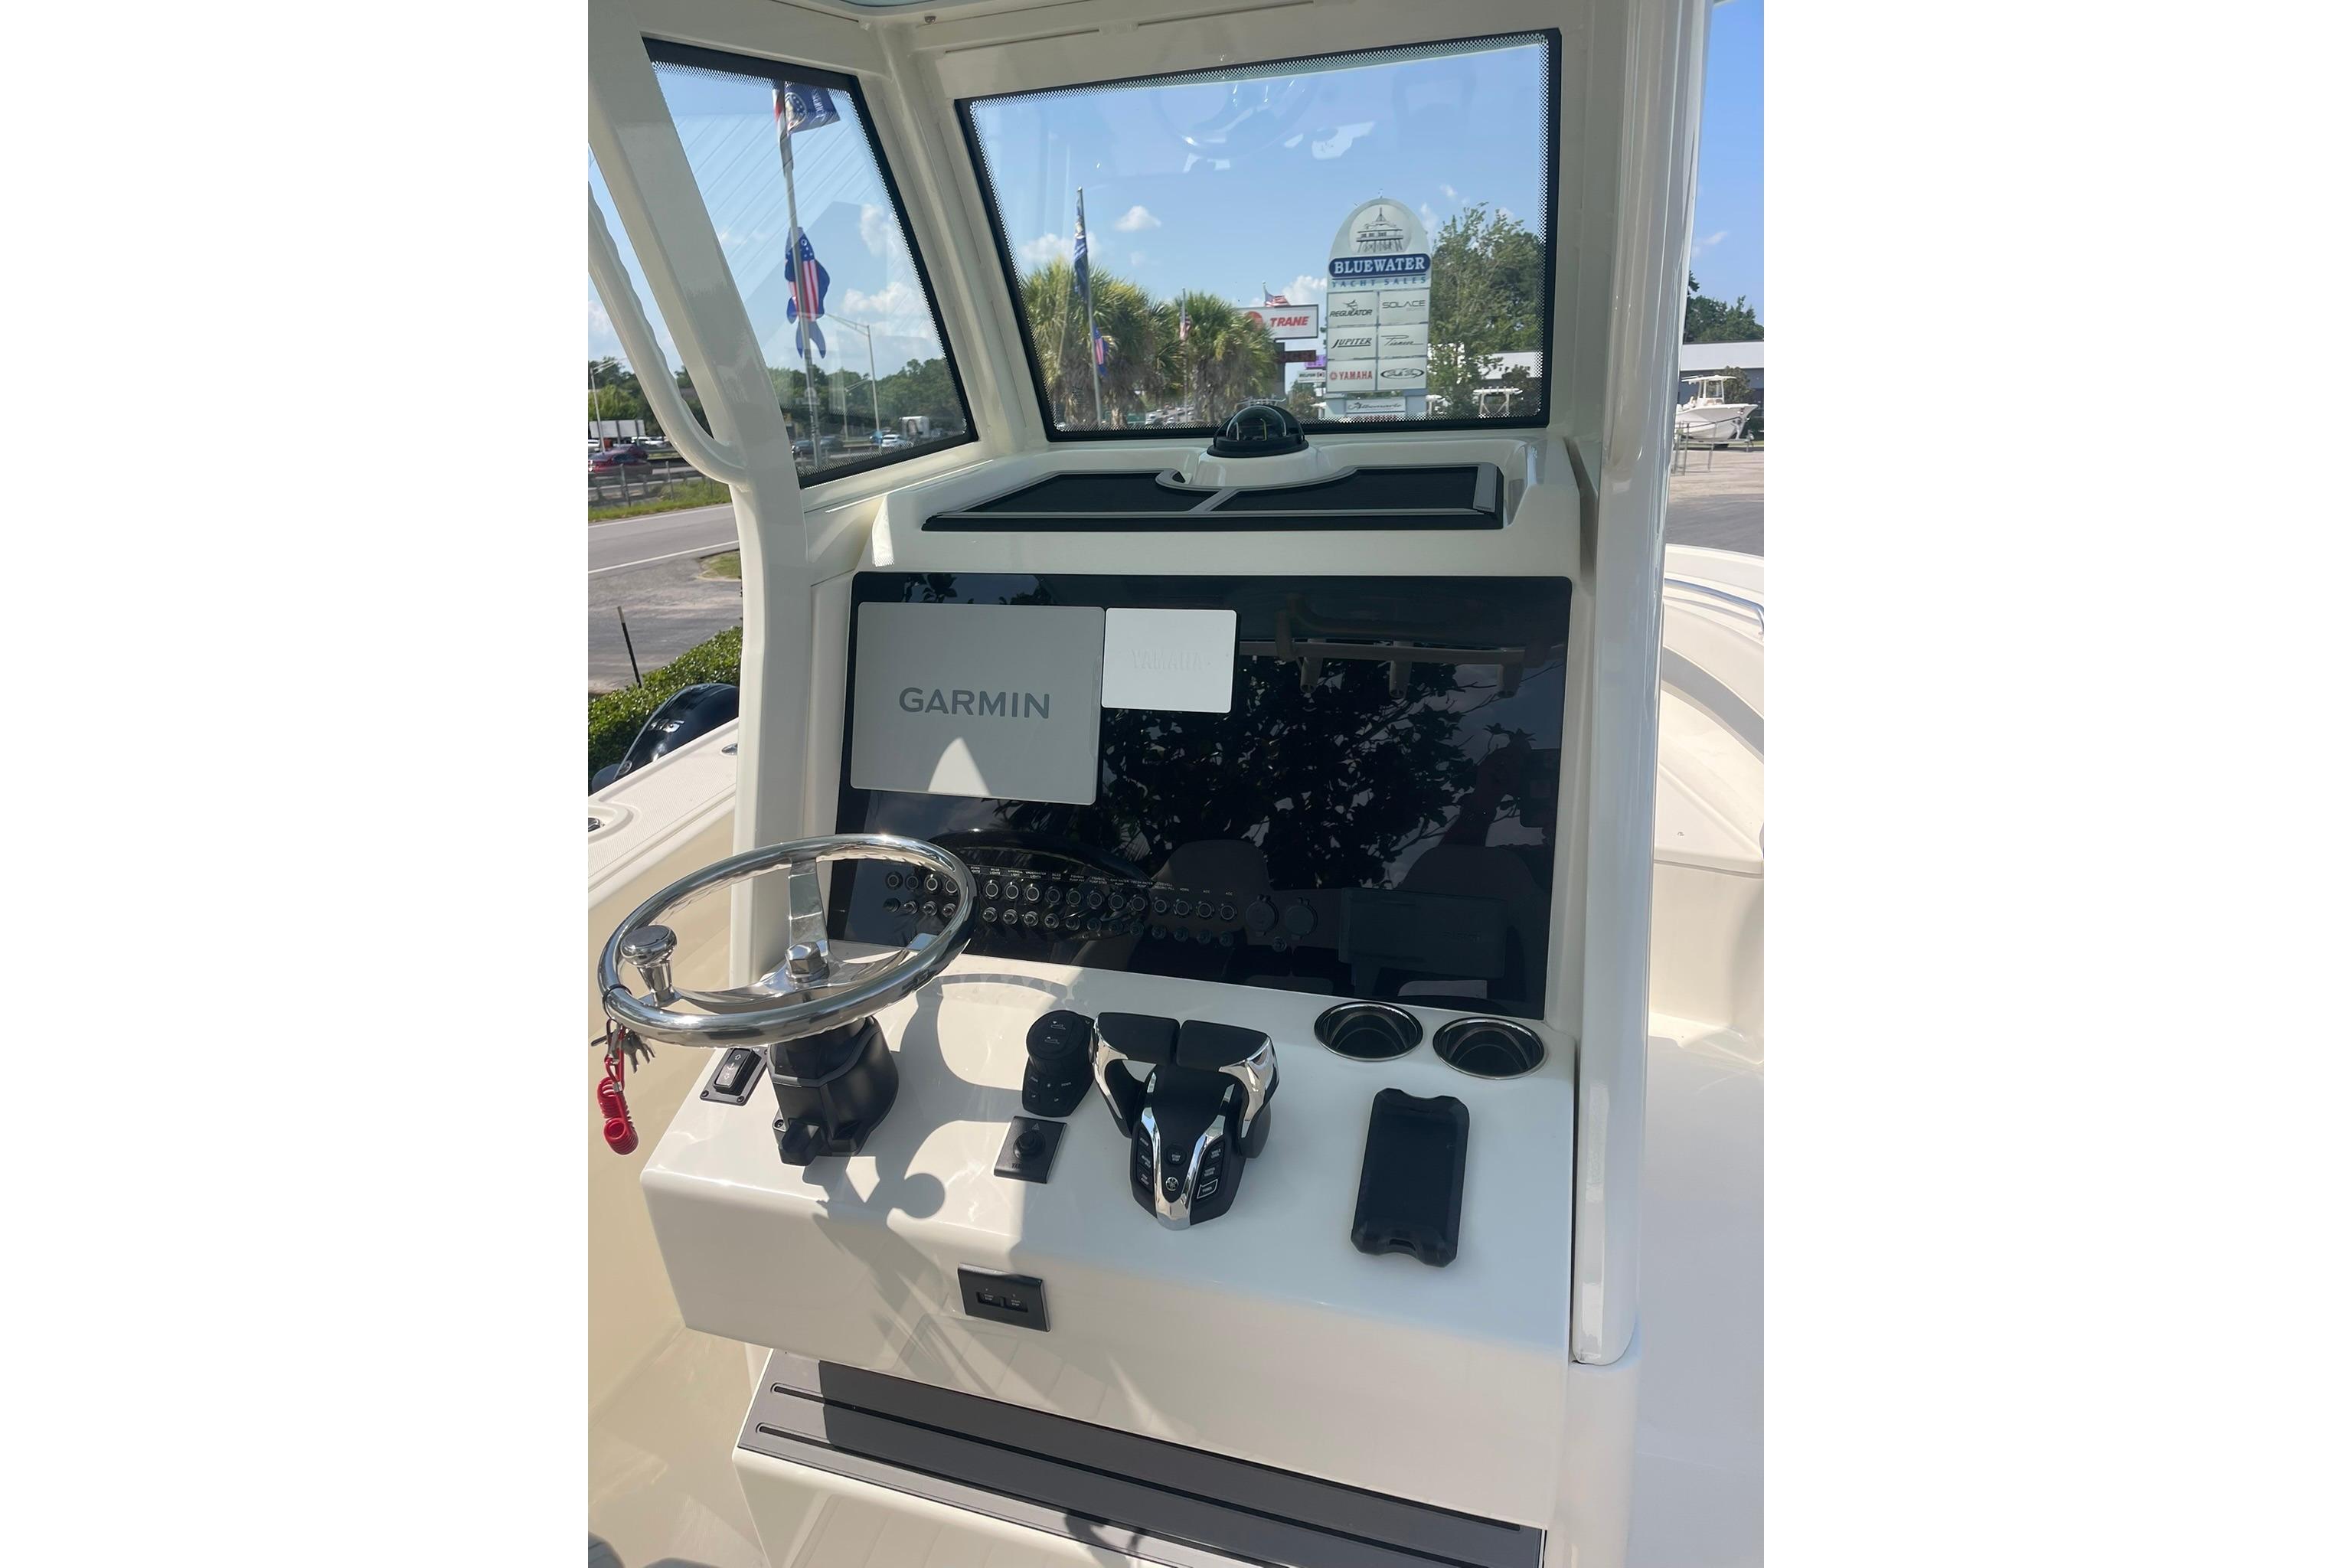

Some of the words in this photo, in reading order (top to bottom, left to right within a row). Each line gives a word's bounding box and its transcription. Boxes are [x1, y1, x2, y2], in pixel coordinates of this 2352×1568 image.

[1334, 256, 1425, 274] BLUEWATER
[1332, 279, 1377, 288] YACHT
[1384, 276, 1426, 286] SALES
[1382, 300, 1426, 309] SOLACE
[1270, 316, 1309, 327] TRANE
[1331, 338, 1372, 349] JUPITER
[1339, 371, 1373, 380] YAMAHA
[899, 687, 1050, 719] GARMIN
